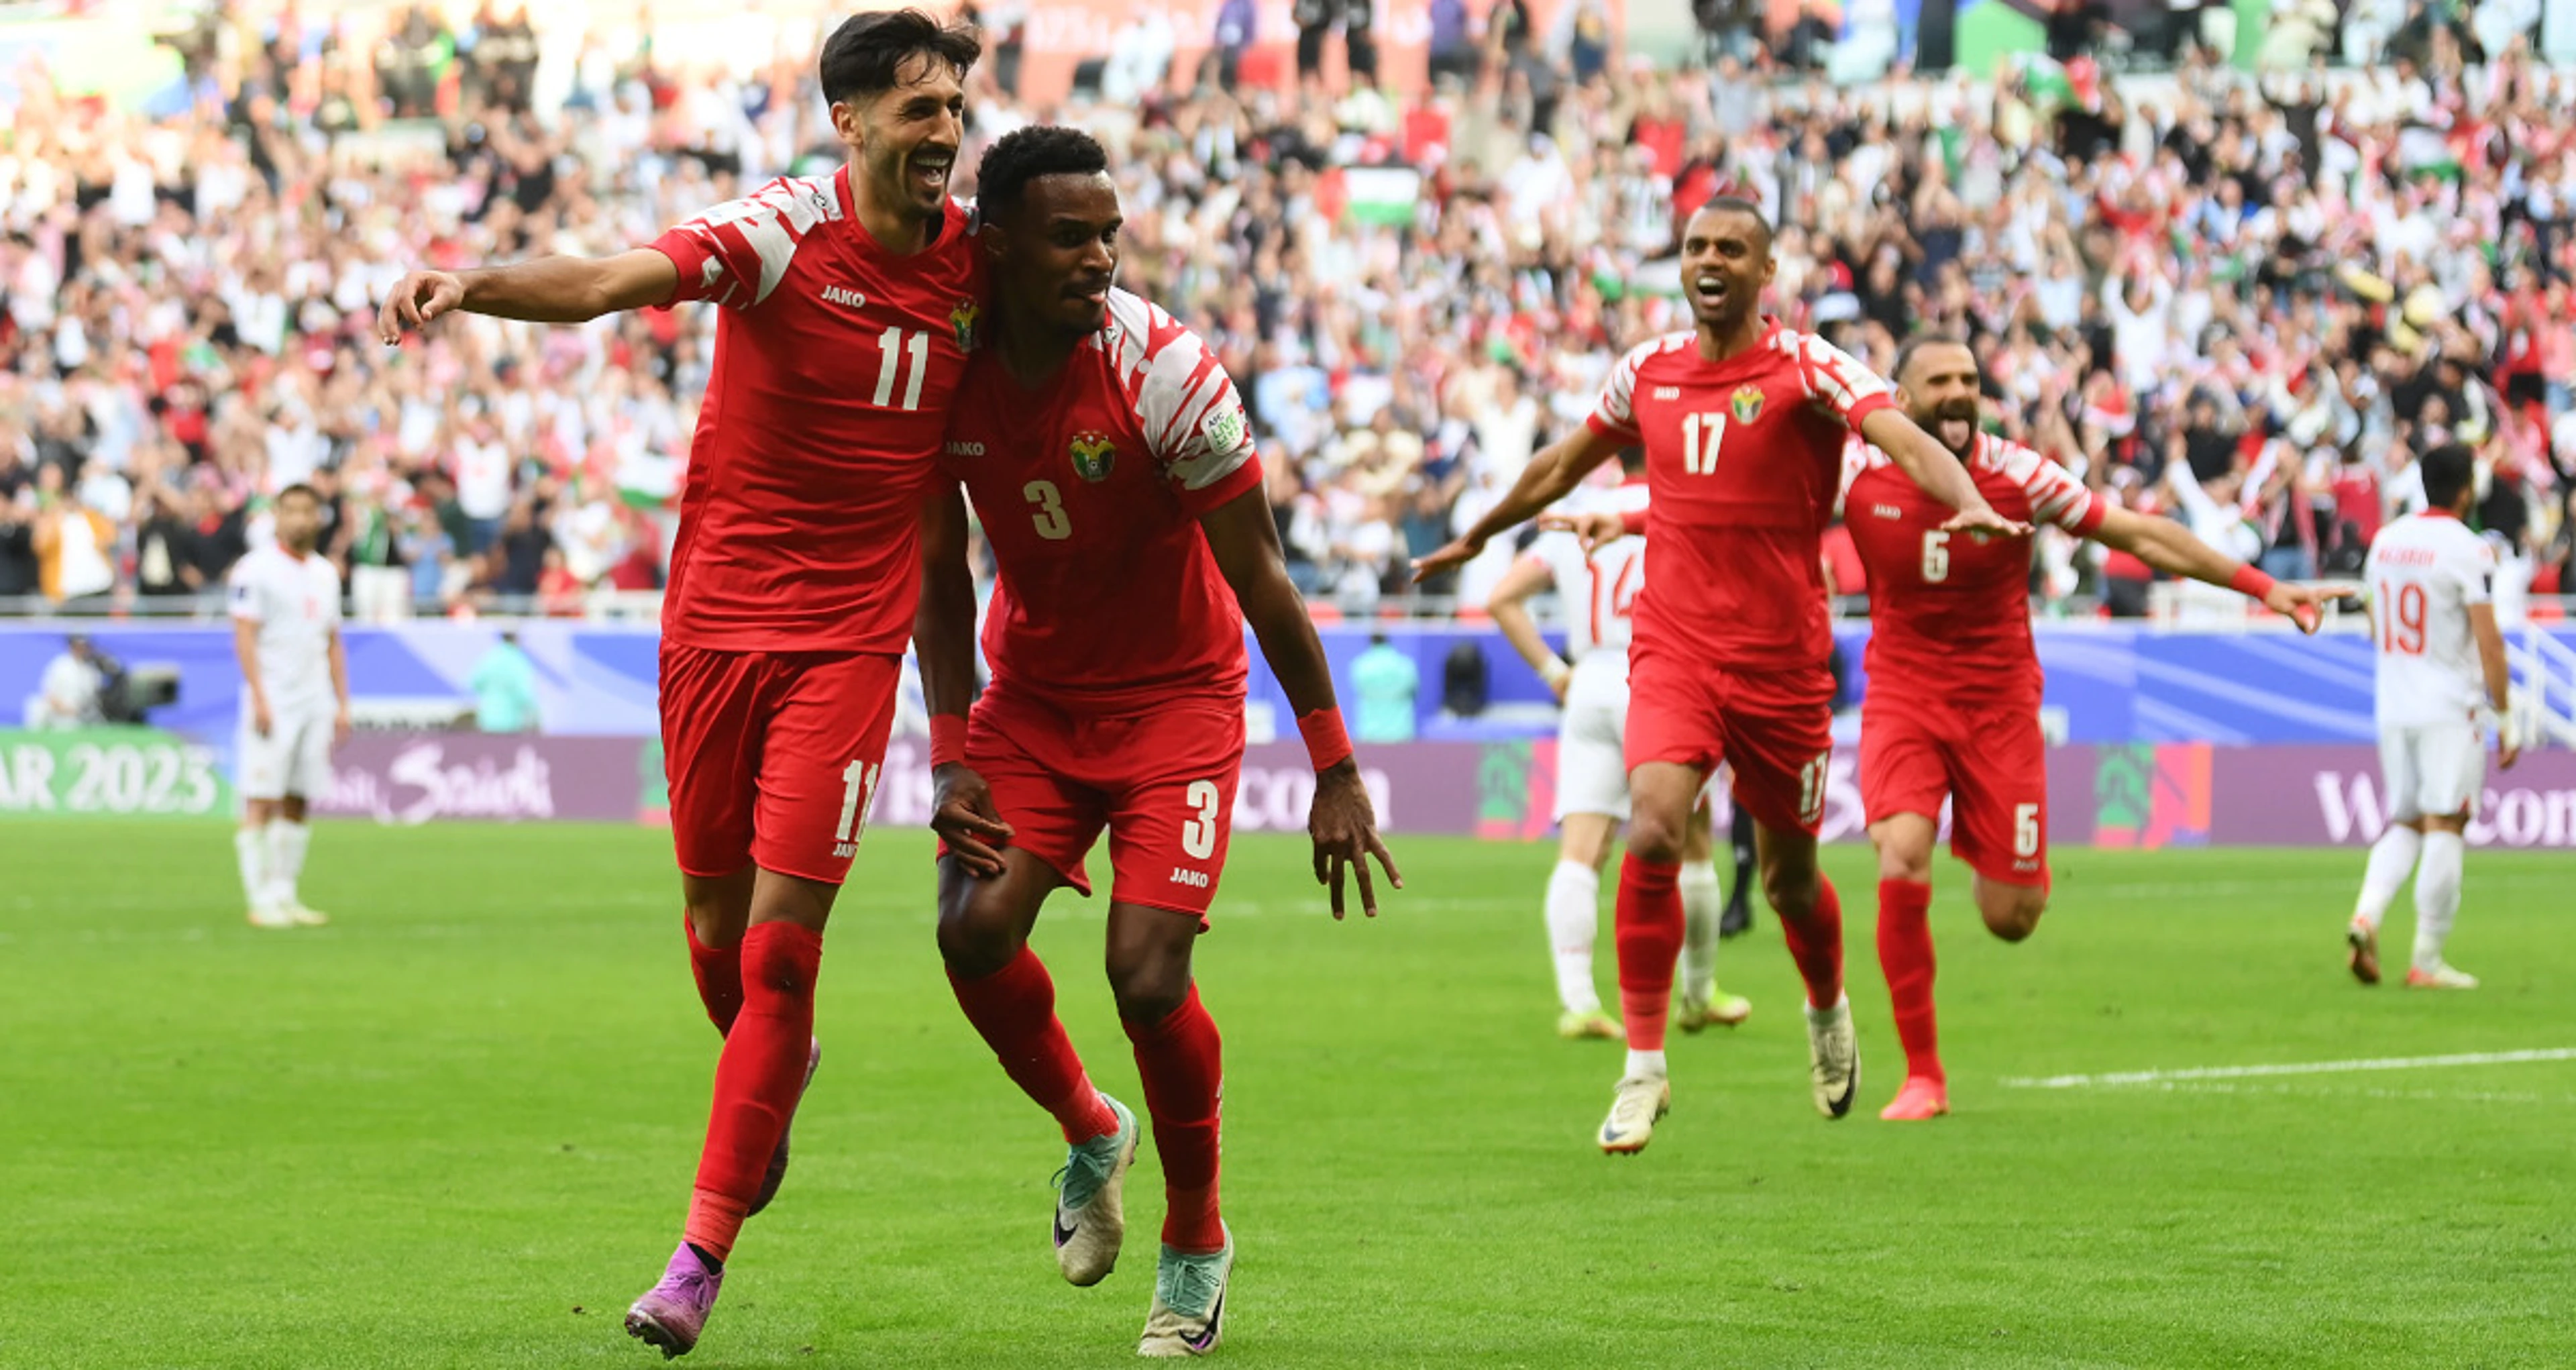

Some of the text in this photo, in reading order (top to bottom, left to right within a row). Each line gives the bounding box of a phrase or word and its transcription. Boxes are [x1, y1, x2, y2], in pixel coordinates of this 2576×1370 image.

[821, 284, 865, 308] JAKO
[872, 326, 929, 411] 11
[1682, 413, 1726, 475] 17
[1023, 480, 1072, 539] 3
[1922, 530, 1950, 583] 5
[2380, 581, 2428, 655] 19
[66, 742, 217, 814] 2023
[835, 760, 879, 843] 11
[1801, 751, 1828, 814] 17
[1182, 780, 1220, 860] 3
[2015, 802, 2039, 857] 5
[1170, 867, 1209, 888] JAKO
